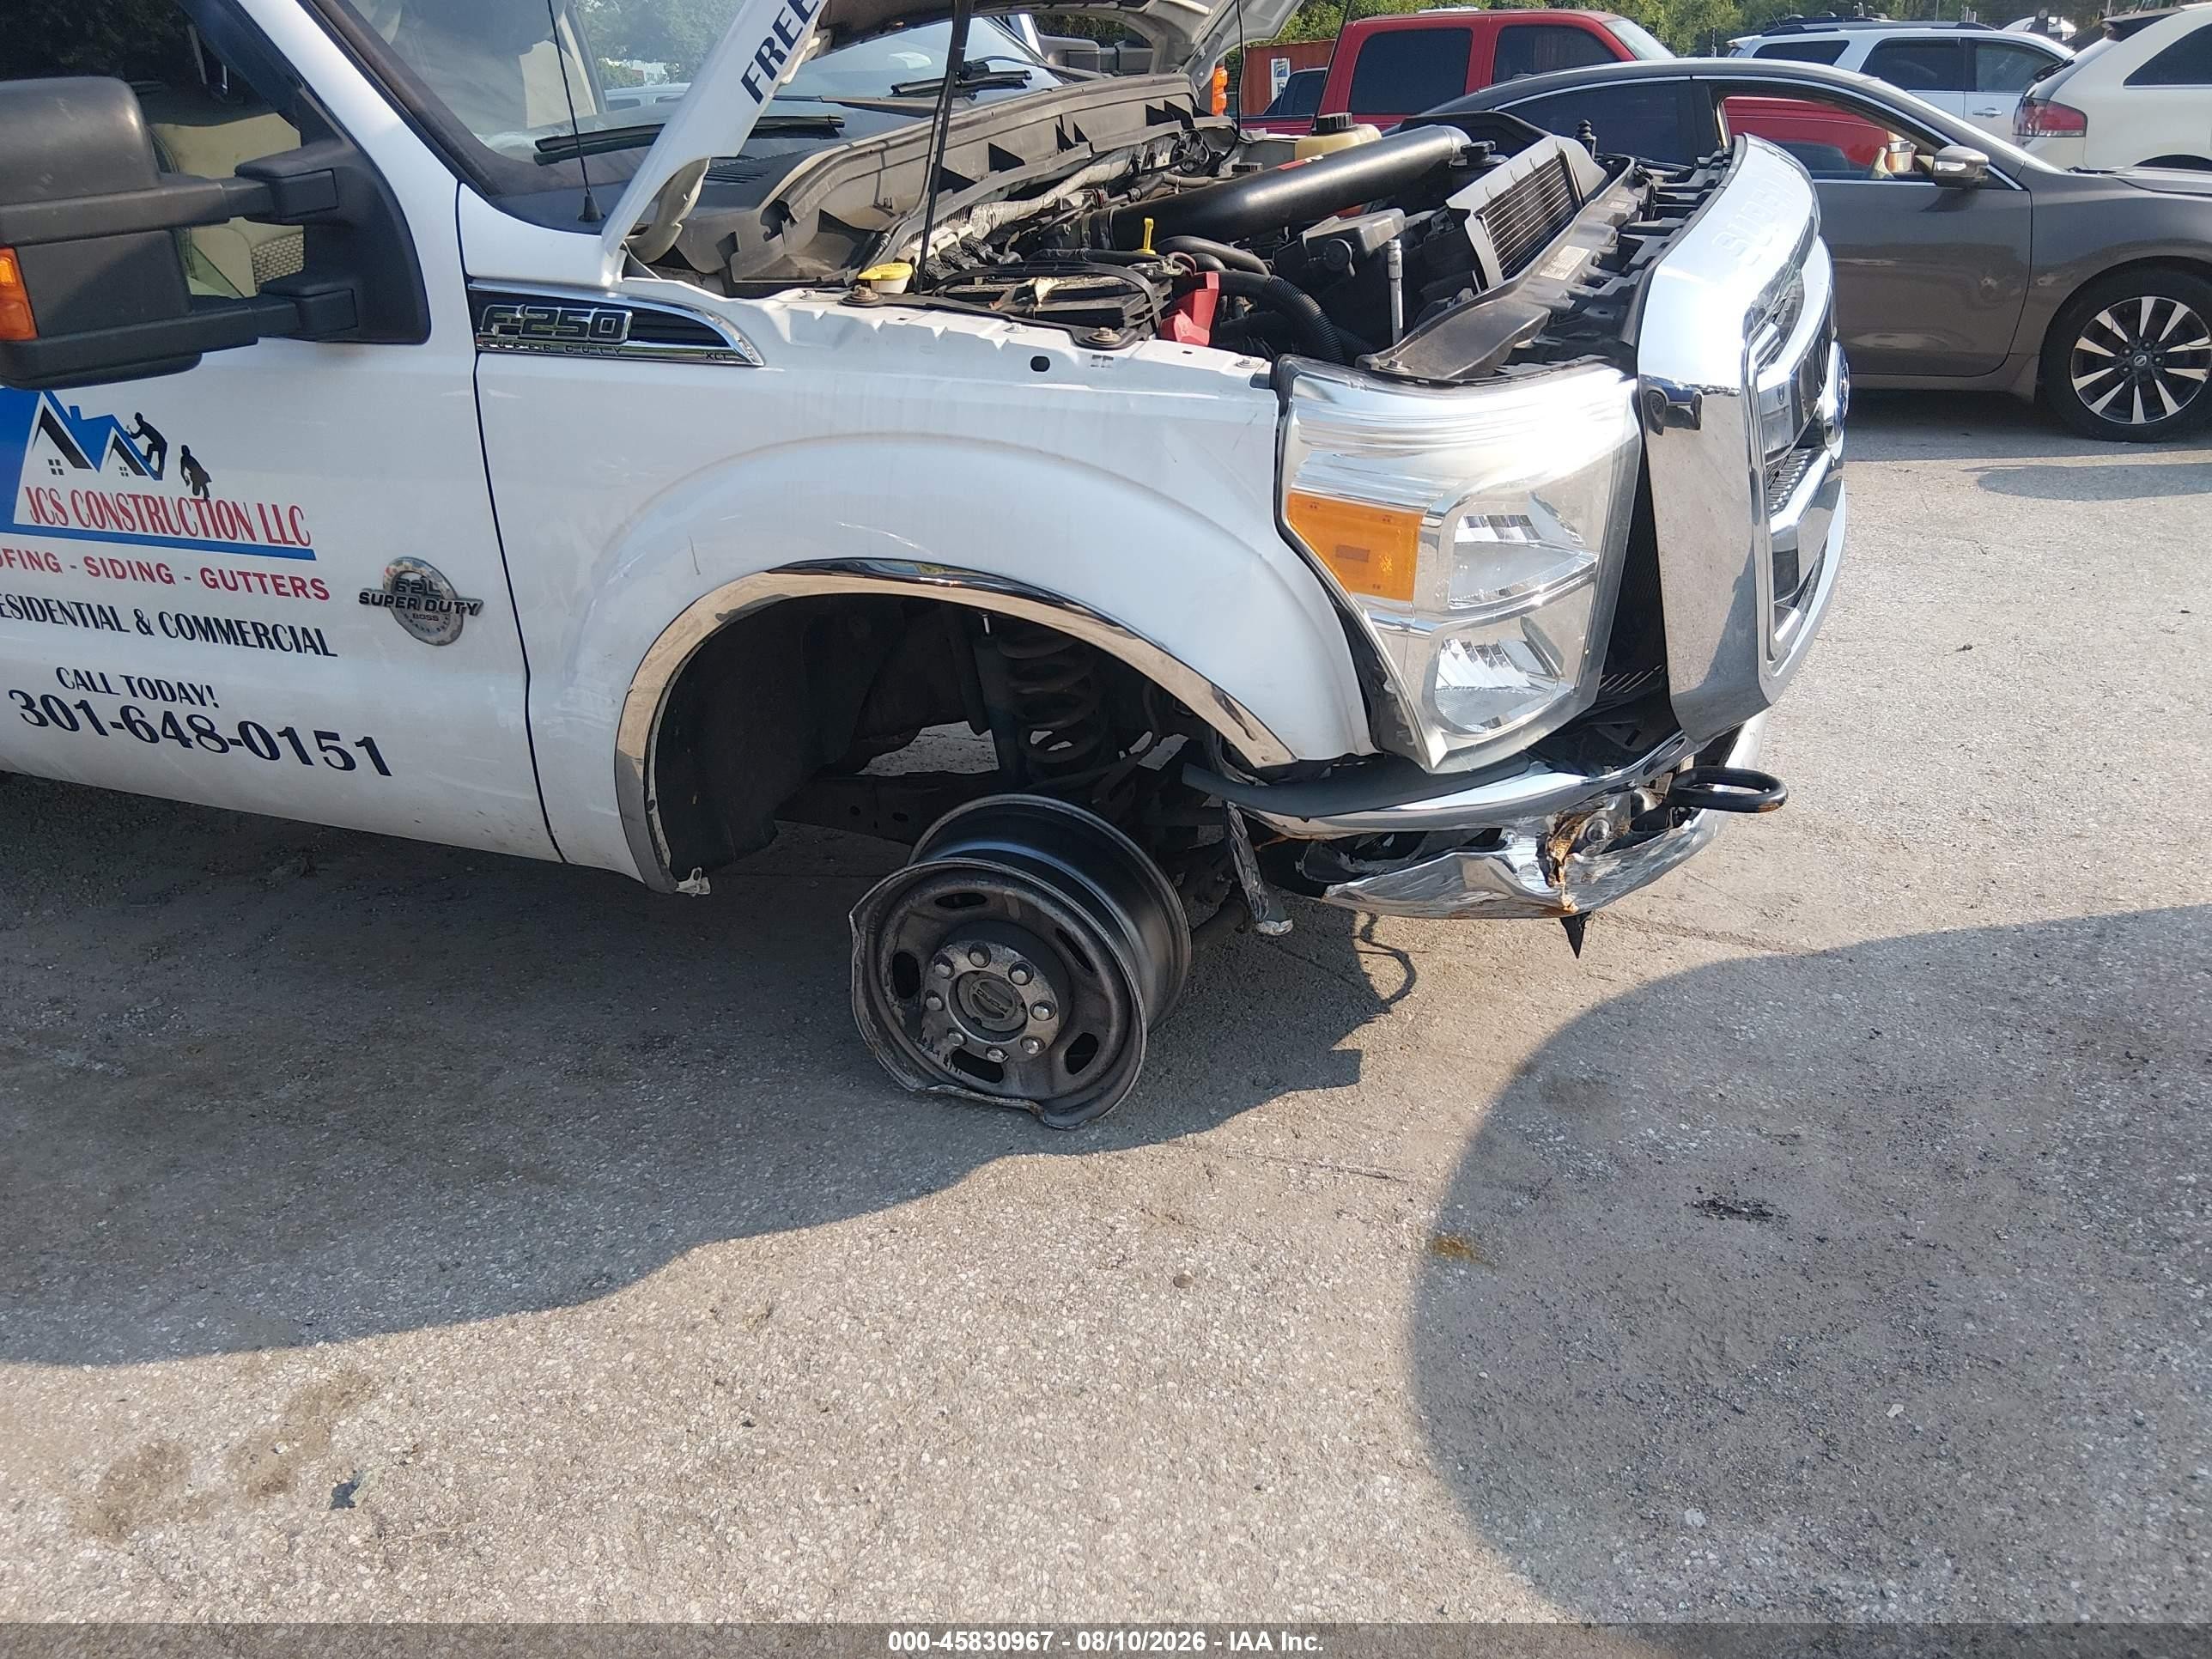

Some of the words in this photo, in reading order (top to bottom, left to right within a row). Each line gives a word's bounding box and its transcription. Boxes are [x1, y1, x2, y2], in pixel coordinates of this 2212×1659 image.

[482, 340, 552, 353] SUPER
[564, 344, 621, 356] DUTY
[705, 351, 729, 361] XLT
[70, 489, 257, 542] CONSTRUCTION
[257, 502, 312, 547] LLC
[0, 548, 63, 574] FING
[83, 556, 176, 585] SIDING
[200, 567, 331, 601] GUTTERS
[359, 592, 421, 611] SUPER
[425, 599, 479, 617] DUTY
[133, 608, 155, 636] &
[158, 611, 338, 658] COMMERCIAL
[56, 666, 121, 696] CALL
[119, 674, 220, 708] TODAY!
[8, 690, 392, 777] 301-648-0151
